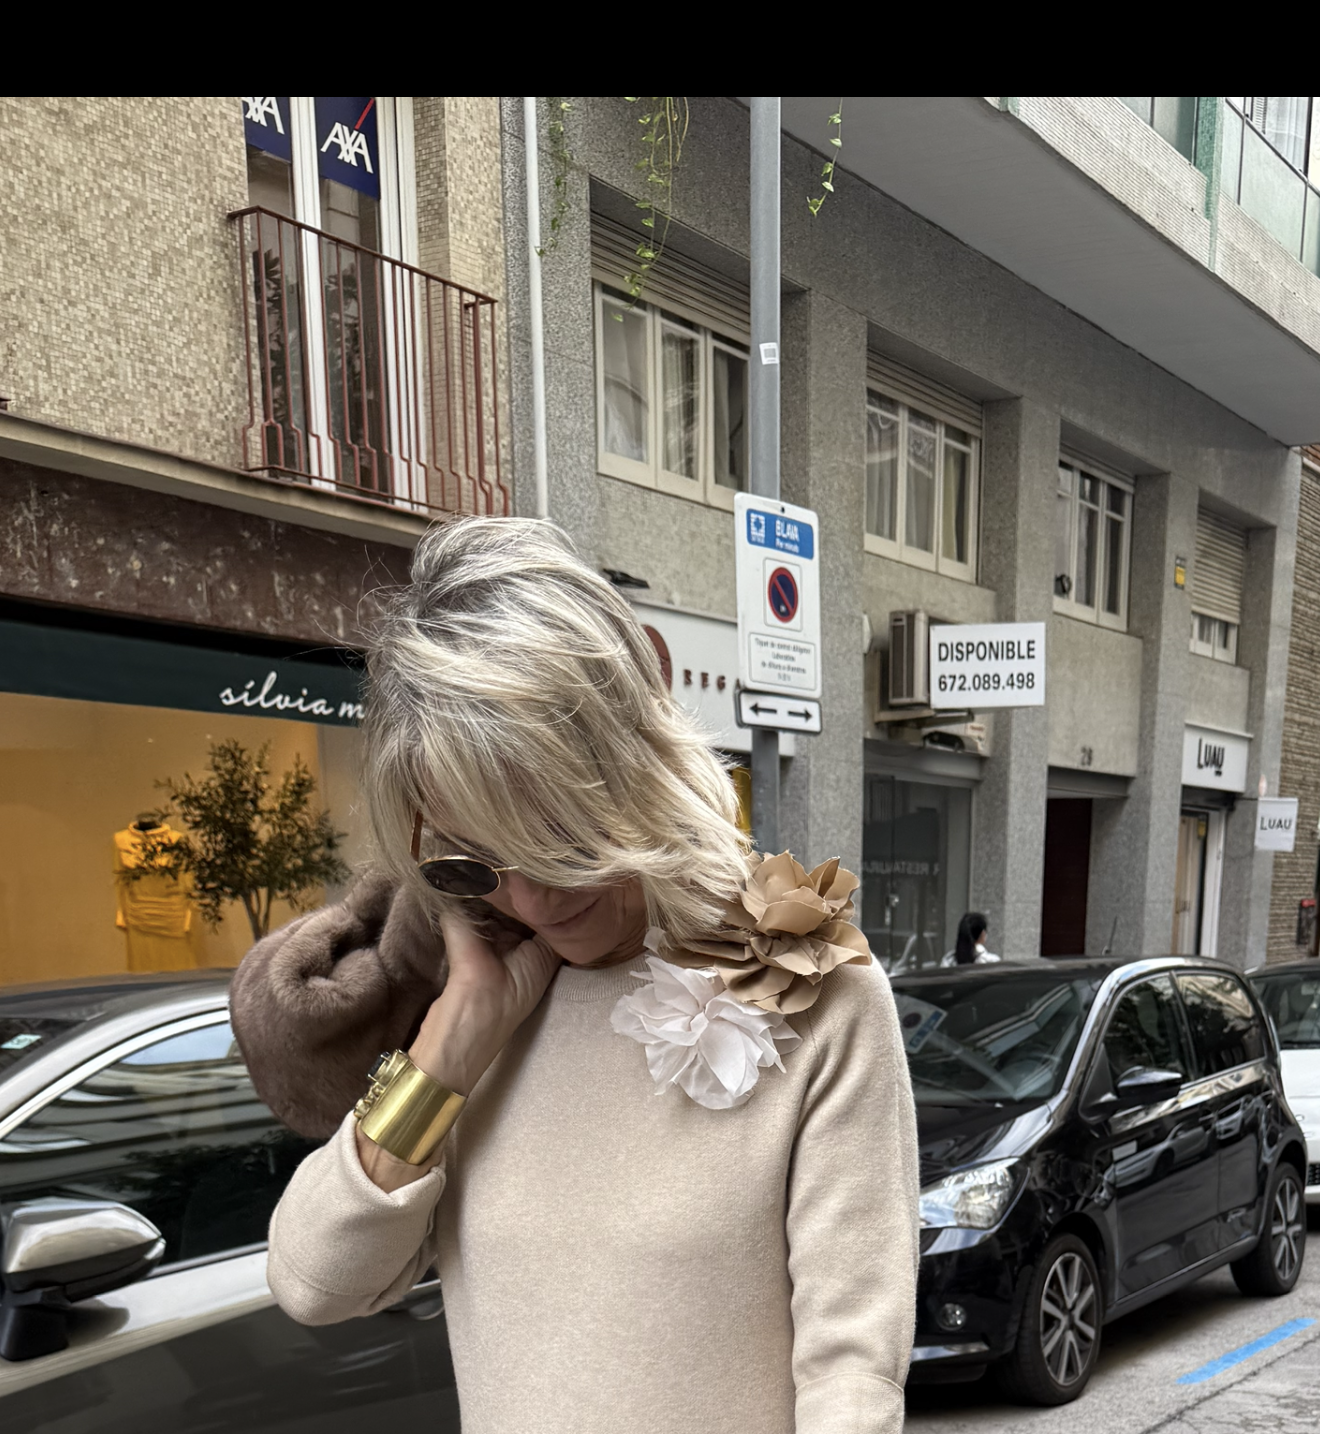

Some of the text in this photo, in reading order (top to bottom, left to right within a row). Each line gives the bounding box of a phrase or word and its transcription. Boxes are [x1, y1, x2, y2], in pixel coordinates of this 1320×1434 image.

[321, 122, 373, 174] AXA
[938, 640, 1036, 663] DISPONIBLE
[938, 672, 1036, 692] 672.089.498
[1260, 817, 1292, 831] LUAU
